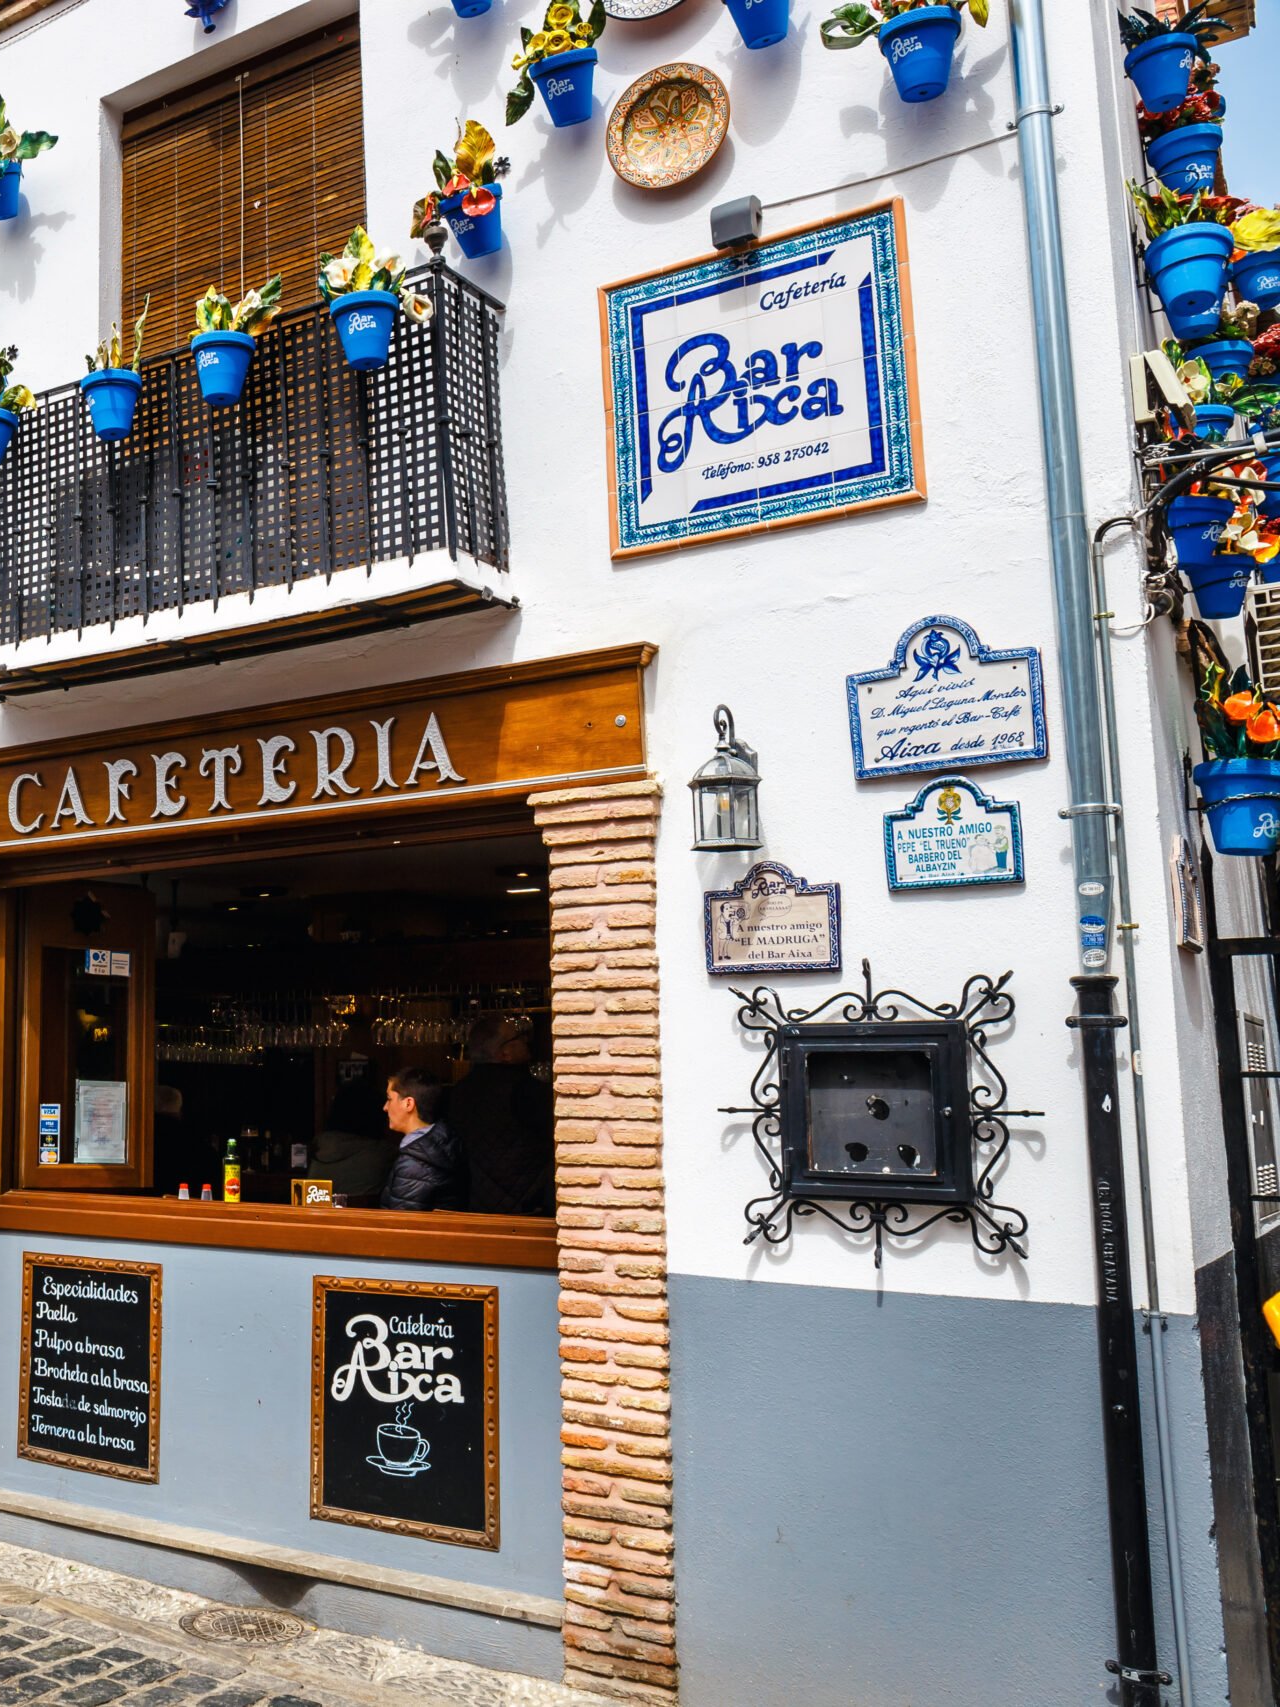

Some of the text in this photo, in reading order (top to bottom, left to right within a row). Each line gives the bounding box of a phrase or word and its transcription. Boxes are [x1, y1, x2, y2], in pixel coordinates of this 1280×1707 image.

[890, 36, 918, 50] Bar
[547, 78, 570, 90] Bar
[760, 272, 846, 311] Cafetería
[348, 312, 373, 323] Bar
[348, 318, 376, 334] Aixa
[199, 351, 217, 360] Bar
[665, 333, 823, 396] Bar
[657, 373, 844, 473] Aixa
[701, 441, 830, 480] Teléfono: 958 275042
[870, 686, 1027, 720] D. Miguel Laguna Morales
[895, 683, 936, 701] Aquí
[876, 704, 1022, 741] que regentó el Bar-Café
[880, 736, 942, 761] Aixa
[951, 735, 985, 751] desde
[992, 731, 1025, 746] 1968
[7, 711, 467, 834] CAFETERIA
[896, 822, 992, 841] A NUESTRO AMIGO
[897, 842, 916, 853] PEPE
[908, 850, 962, 864] BARBERO DEL
[915, 862, 957, 872] ALBAYZIN
[737, 922, 822, 932] A nuestro amigo
[748, 949, 812, 959] del Bar Aixa
[306, 1190, 331, 1204] Aixa
[308, 1185, 329, 1198] Bar
[42, 1275, 138, 1304] Especialidades
[36, 1301, 78, 1323] Paella
[34, 1328, 125, 1360] Pulpo a brasa
[345, 1313, 454, 1371] Bar
[34, 1357, 150, 1394] Brocheta a la brasa
[331, 1341, 465, 1404] Aixa
[78, 1395, 91, 1413] de
[93, 1399, 146, 1428] salmorejo
[31, 1414, 136, 1451] Ternera a la brasa
